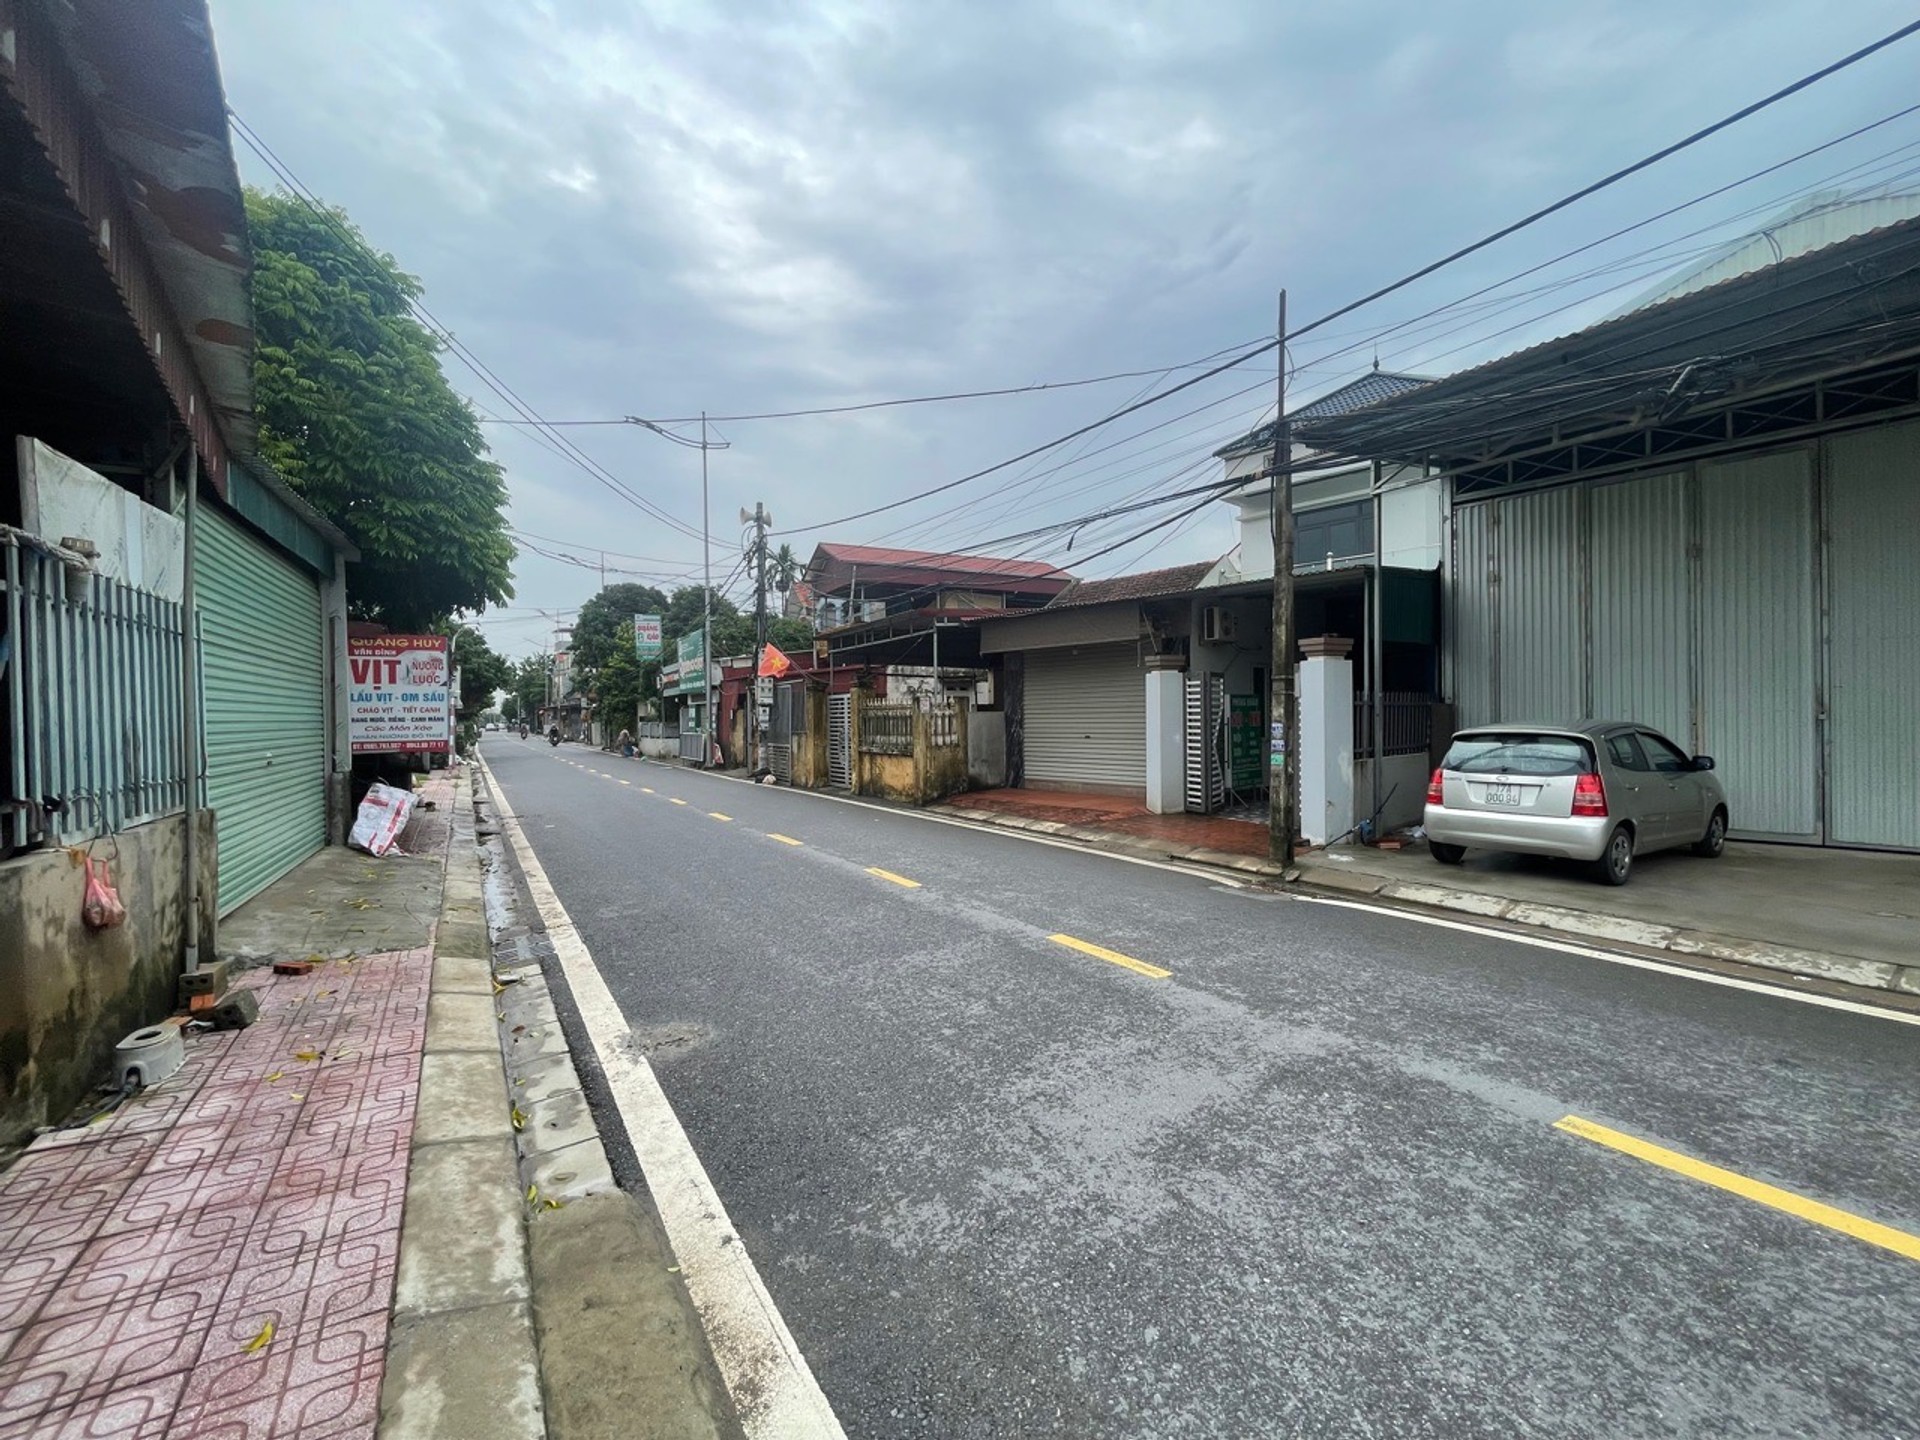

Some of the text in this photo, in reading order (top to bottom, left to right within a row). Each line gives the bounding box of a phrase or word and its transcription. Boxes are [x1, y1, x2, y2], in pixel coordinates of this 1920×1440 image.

[351, 638, 441, 648] QUANG HUY
[349, 659, 401, 690] VỊT
[376, 693, 393, 705] VỊT
[401, 693, 420, 702] OM
[382, 707, 394, 716] VỊT
